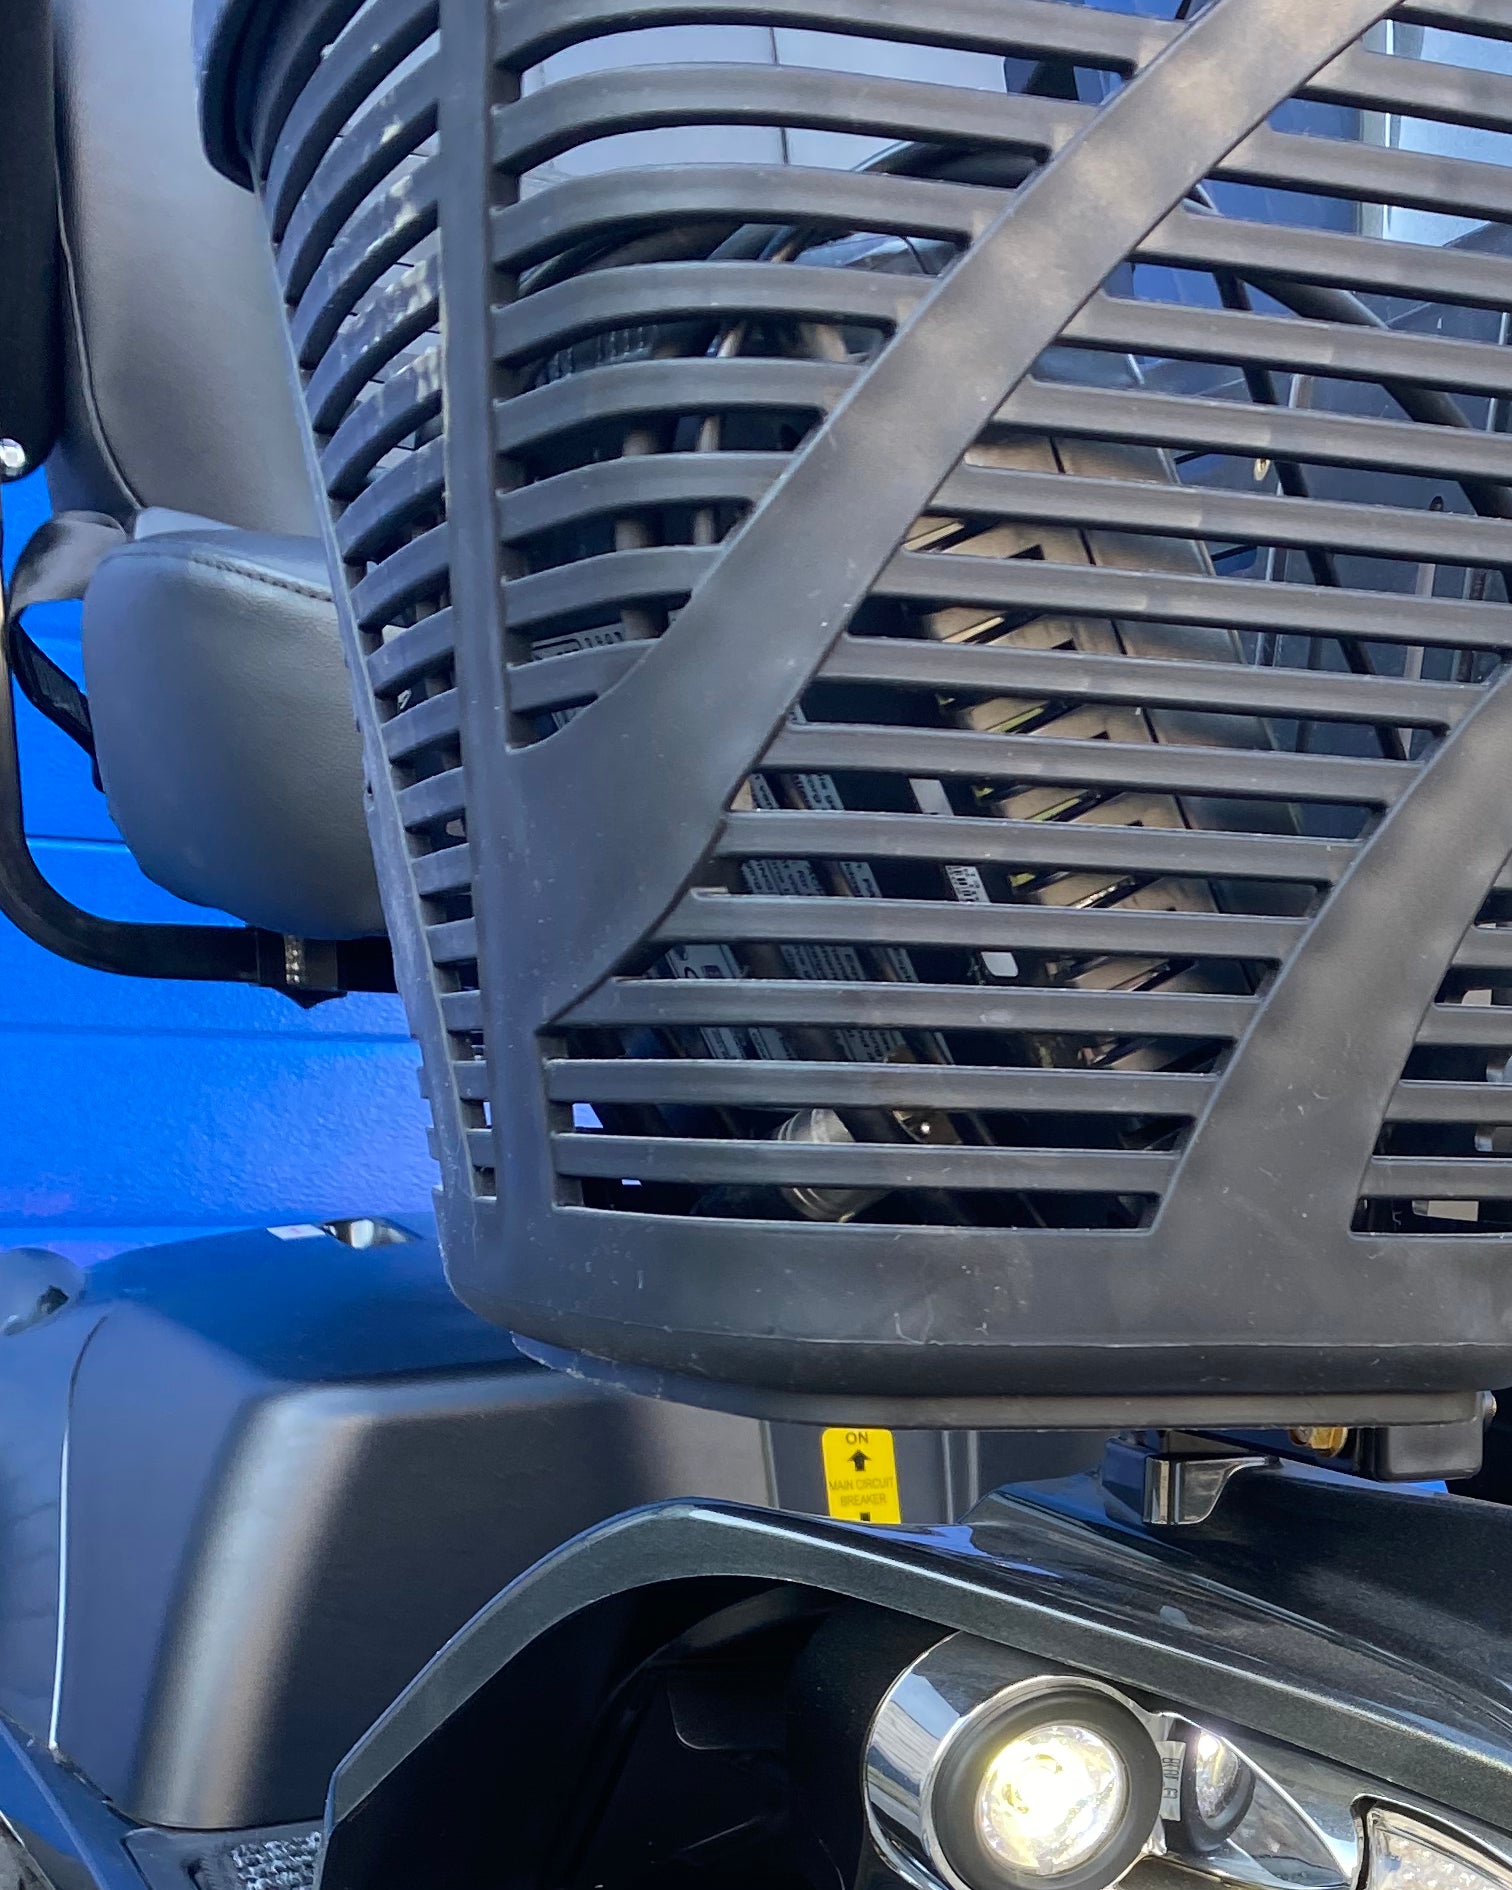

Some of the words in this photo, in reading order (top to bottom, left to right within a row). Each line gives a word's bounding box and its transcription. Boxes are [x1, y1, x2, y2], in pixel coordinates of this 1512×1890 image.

[845, 1432, 869, 1445] ON
[829, 1478, 854, 1491] MAIN
[857, 1477, 893, 1490] CIRCUIT
[840, 1494, 887, 1506] BREAKER
